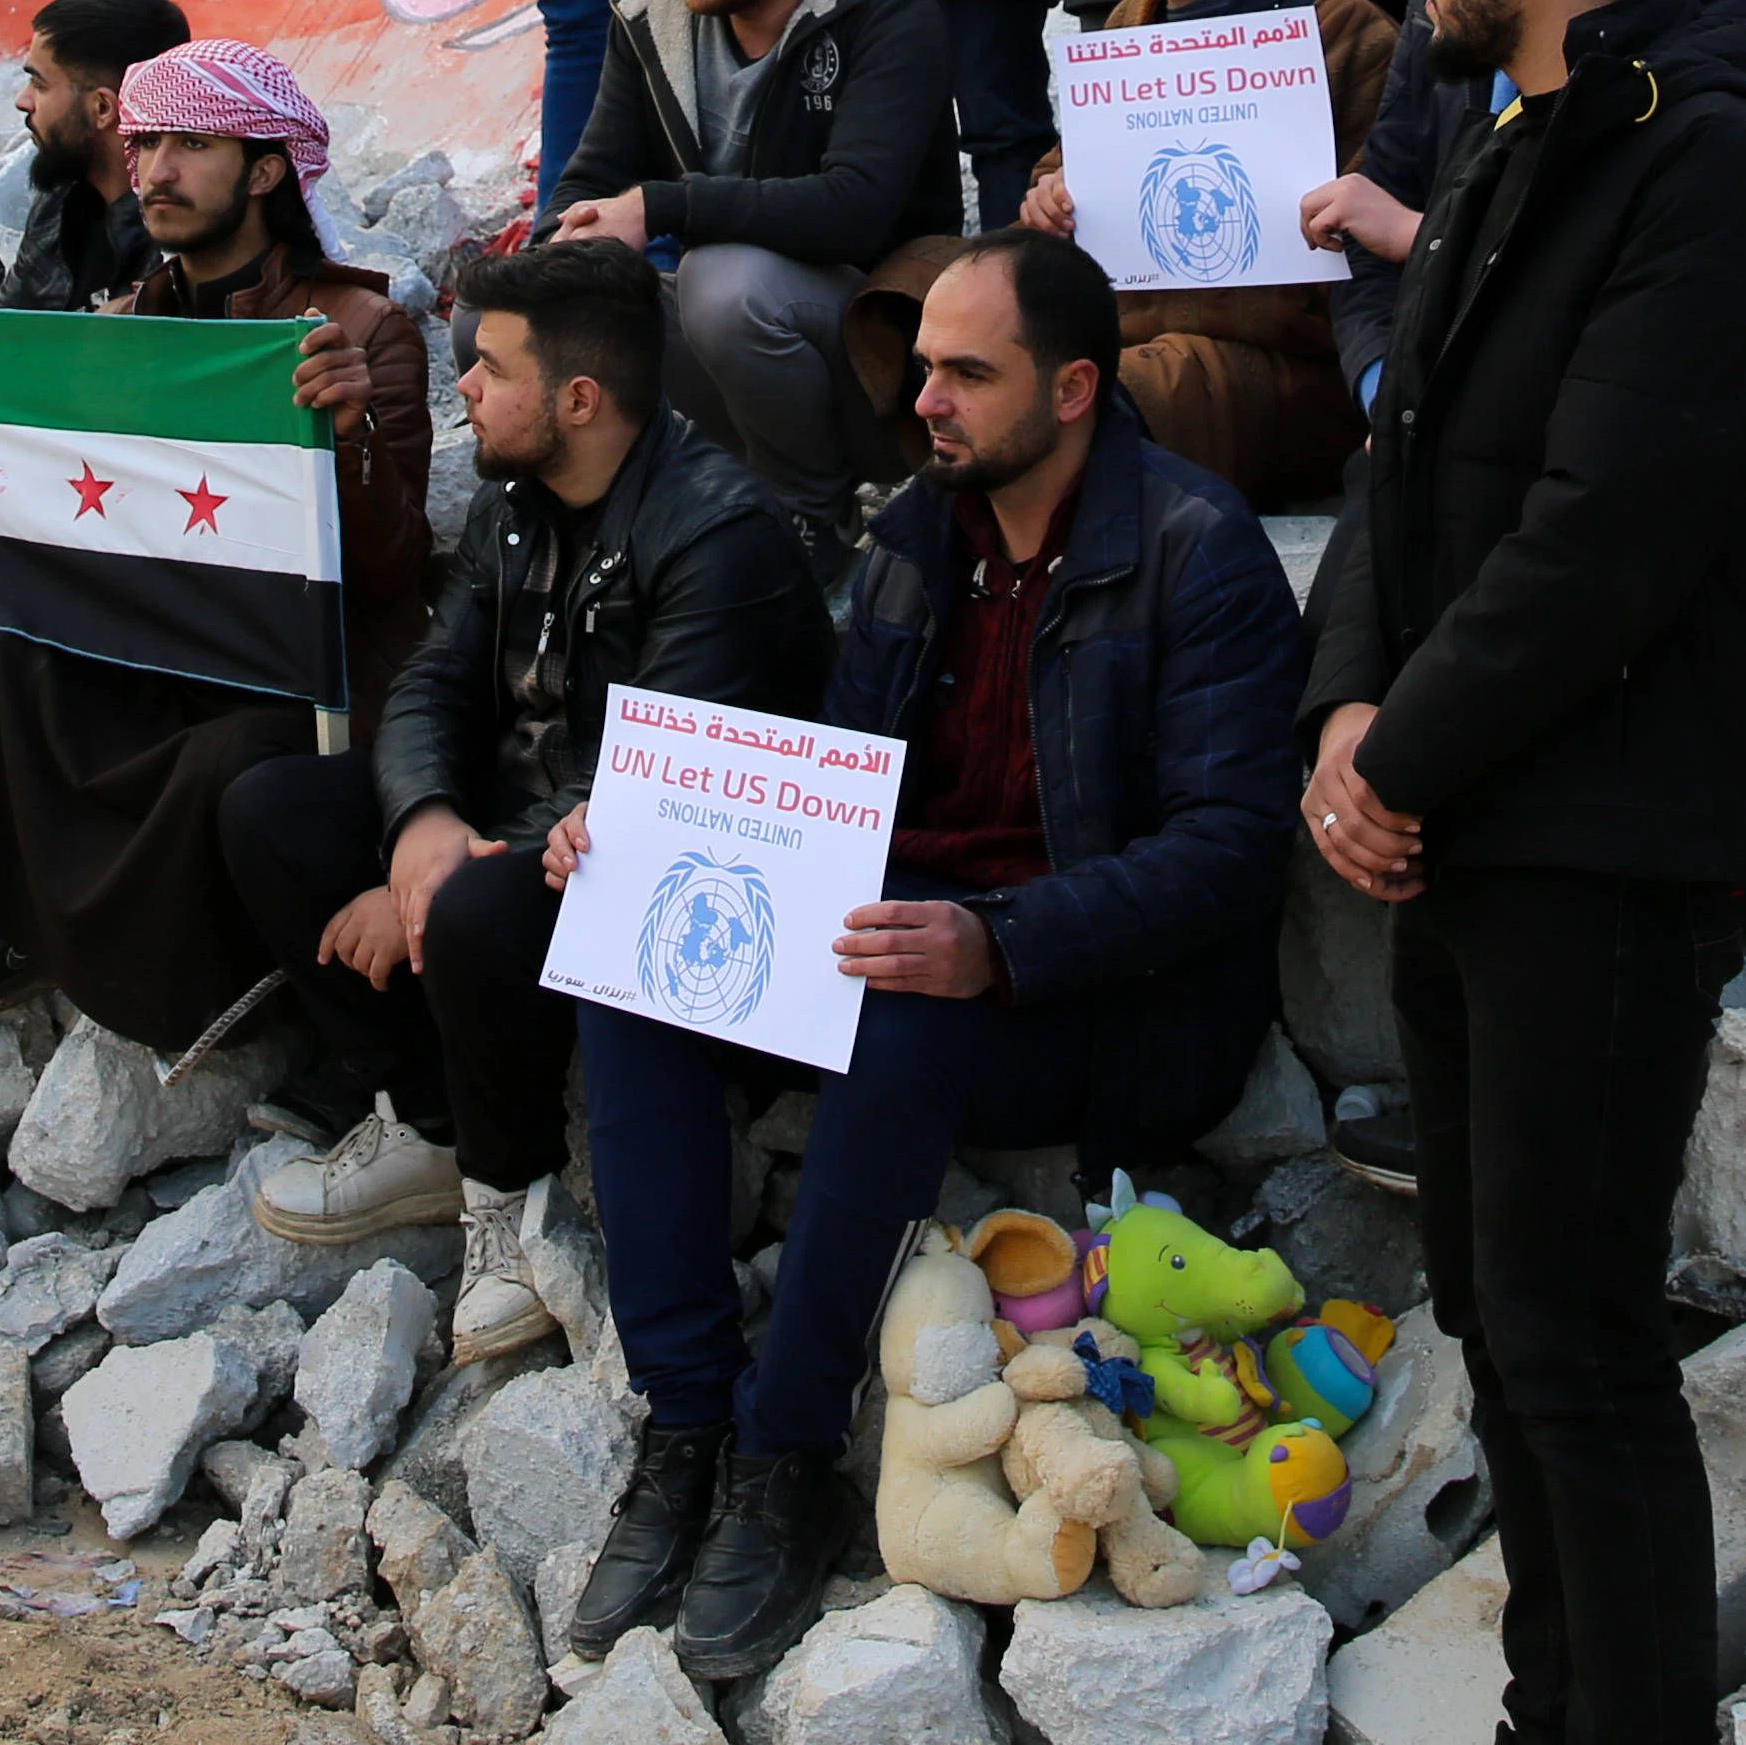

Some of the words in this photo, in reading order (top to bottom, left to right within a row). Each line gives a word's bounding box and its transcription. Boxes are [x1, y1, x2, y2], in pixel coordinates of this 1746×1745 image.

[1149, 26, 1245, 55] المتحدة
[1252, 17, 1308, 48] الأمم
[1066, 41, 1142, 64] خذلتنا
[1070, 80, 1112, 107] UN
[1121, 76, 1167, 102] Let
[1175, 70, 1217, 96] US
[1227, 65, 1316, 93] Down
[1126, 107, 1193, 131] NATIONS
[1198, 102, 1258, 124] UNITED
[620, 698, 698, 735] خذلتنا
[705, 714, 815, 759] المتحدة
[818, 743, 892, 776] الأمم
[611, 744, 656, 780] UN
[661, 756, 714, 794] Let
[722, 768, 769, 805] US
[776, 780, 882, 831] Down
[657, 797, 734, 833] NATIONS
[737, 817, 803, 850] UNITED
